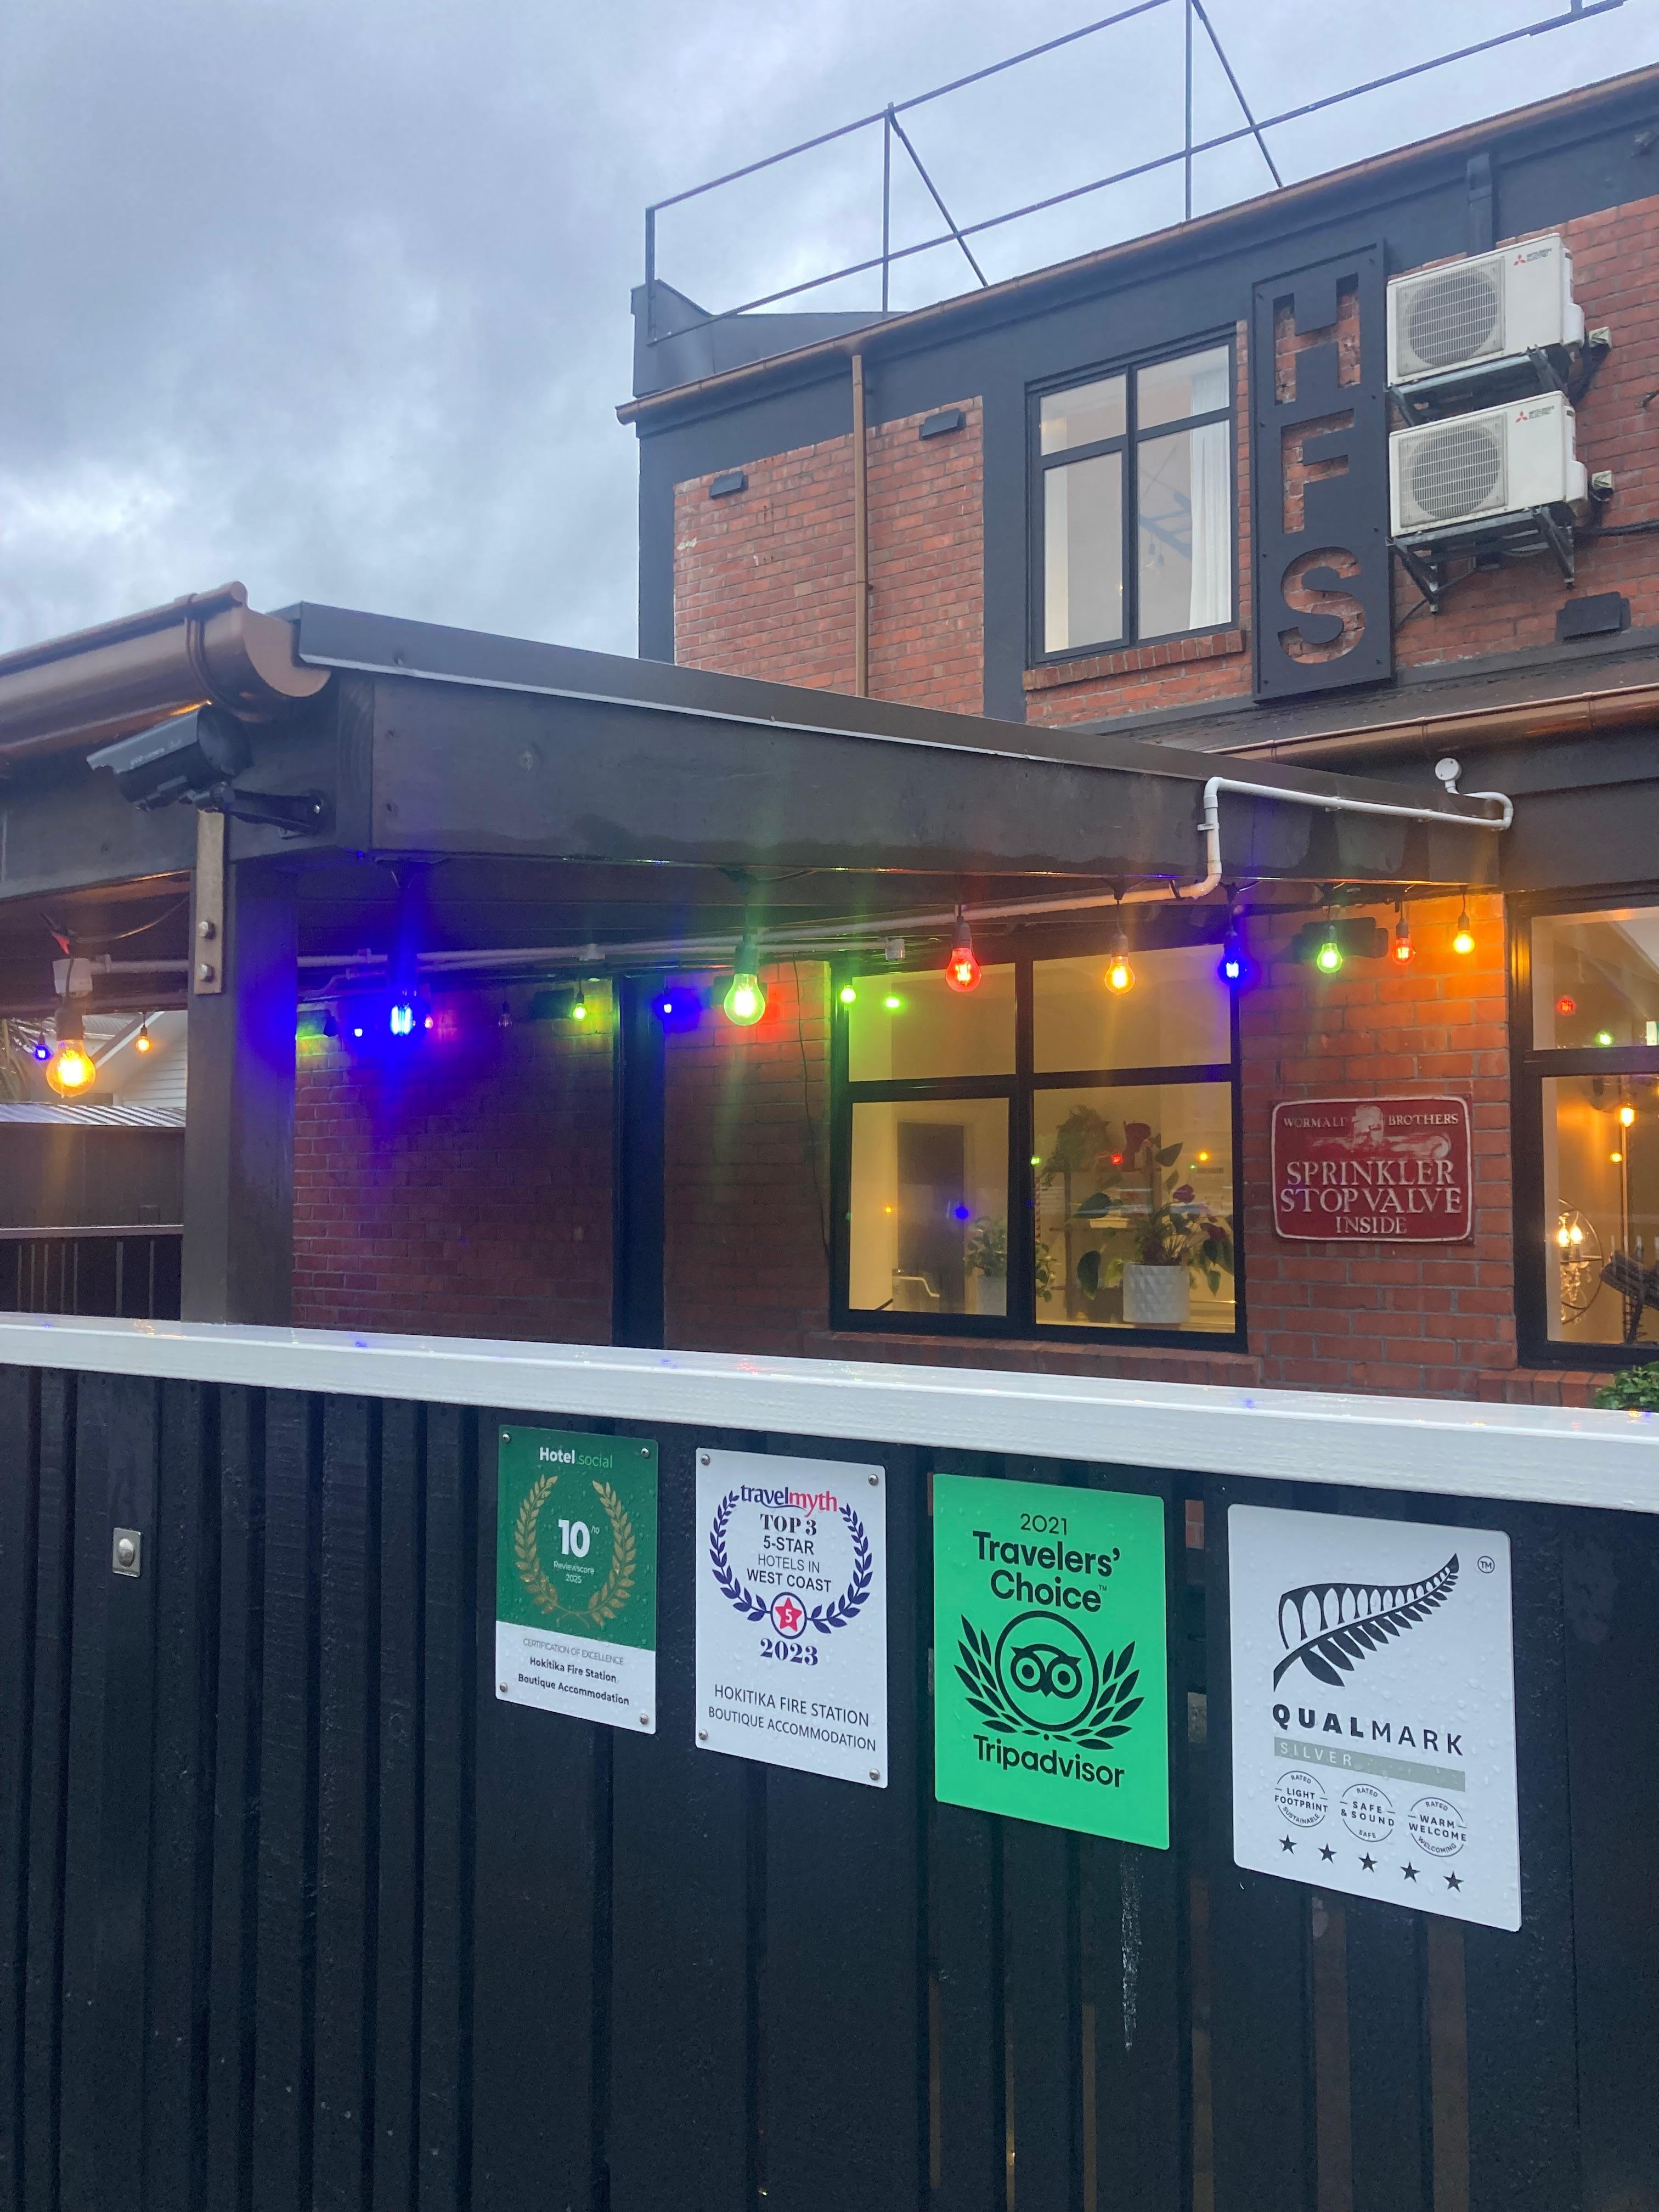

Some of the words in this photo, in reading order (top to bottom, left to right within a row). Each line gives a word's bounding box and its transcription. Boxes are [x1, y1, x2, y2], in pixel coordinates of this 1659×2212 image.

[1389, 1113, 1459, 1125] BROTHERS
[1286, 1159, 1455, 1186] SPRINKLER
[1336, 1216, 1407, 1234] INSIDE
[741, 1485, 837, 1517] travelmyth
[760, 1514, 801, 1533] TOP
[805, 1519, 817, 1536] 3
[1020, 1513, 1067, 1535] 2021
[558, 1519, 590, 1558] 10
[764, 1535, 814, 1555] 5-STAR
[758, 1554, 804, 1571] HOTELS
[809, 1561, 820, 1573] IN
[747, 1568, 783, 1585] WEST
[787, 1575, 832, 1592] COAST
[991, 1569, 1102, 1612] Choice
[785, 1609, 792, 1623] 5
[523, 1638, 569, 1655] CERTIFICATION
[571, 1647, 581, 1656] OF
[582, 1650, 624, 1666] EXCELLENCE
[760, 1638, 818, 1666] 2023
[530, 1656, 565, 1672] Hokitika
[567, 1664, 583, 1675] Fire
[585, 1668, 617, 1683] Station
[518, 1673, 556, 1689] Boutique
[558, 1682, 629, 1705] Accommodation
[715, 1684, 775, 1709] HOKITIKA
[780, 1696, 806, 1714] FIRE
[811, 1703, 869, 1726] STATION
[709, 1706, 764, 1728] BOUTIQUE
[768, 1719, 876, 1752] ACCOMMODATION
[1272, 1703, 1463, 1756] QUALMARK
[973, 1734, 1125, 1788] Tripadvisor
[1280, 1741, 1352, 1767] SILVER
[1291, 1774, 1312, 1784] RATED
[1286, 1787, 1315, 1800] LIGHT
[1357, 1787, 1378, 1797] RATED
[1274, 1795, 1328, 1812] FOOTPRINT
[1352, 1801, 1382, 1814] SAFE
[1425, 1801, 1448, 1811] RATED
[1283, 1807, 1320, 1824] SUSTAINABLE
[1351, 1811, 1395, 1826] SOUND
[1420, 1814, 1455, 1829] WARM
[1358, 1830, 1376, 1838] SAFE
[1408, 1822, 1466, 1842] WELCOME
[1418, 1836, 1457, 1853] WELCOMING
